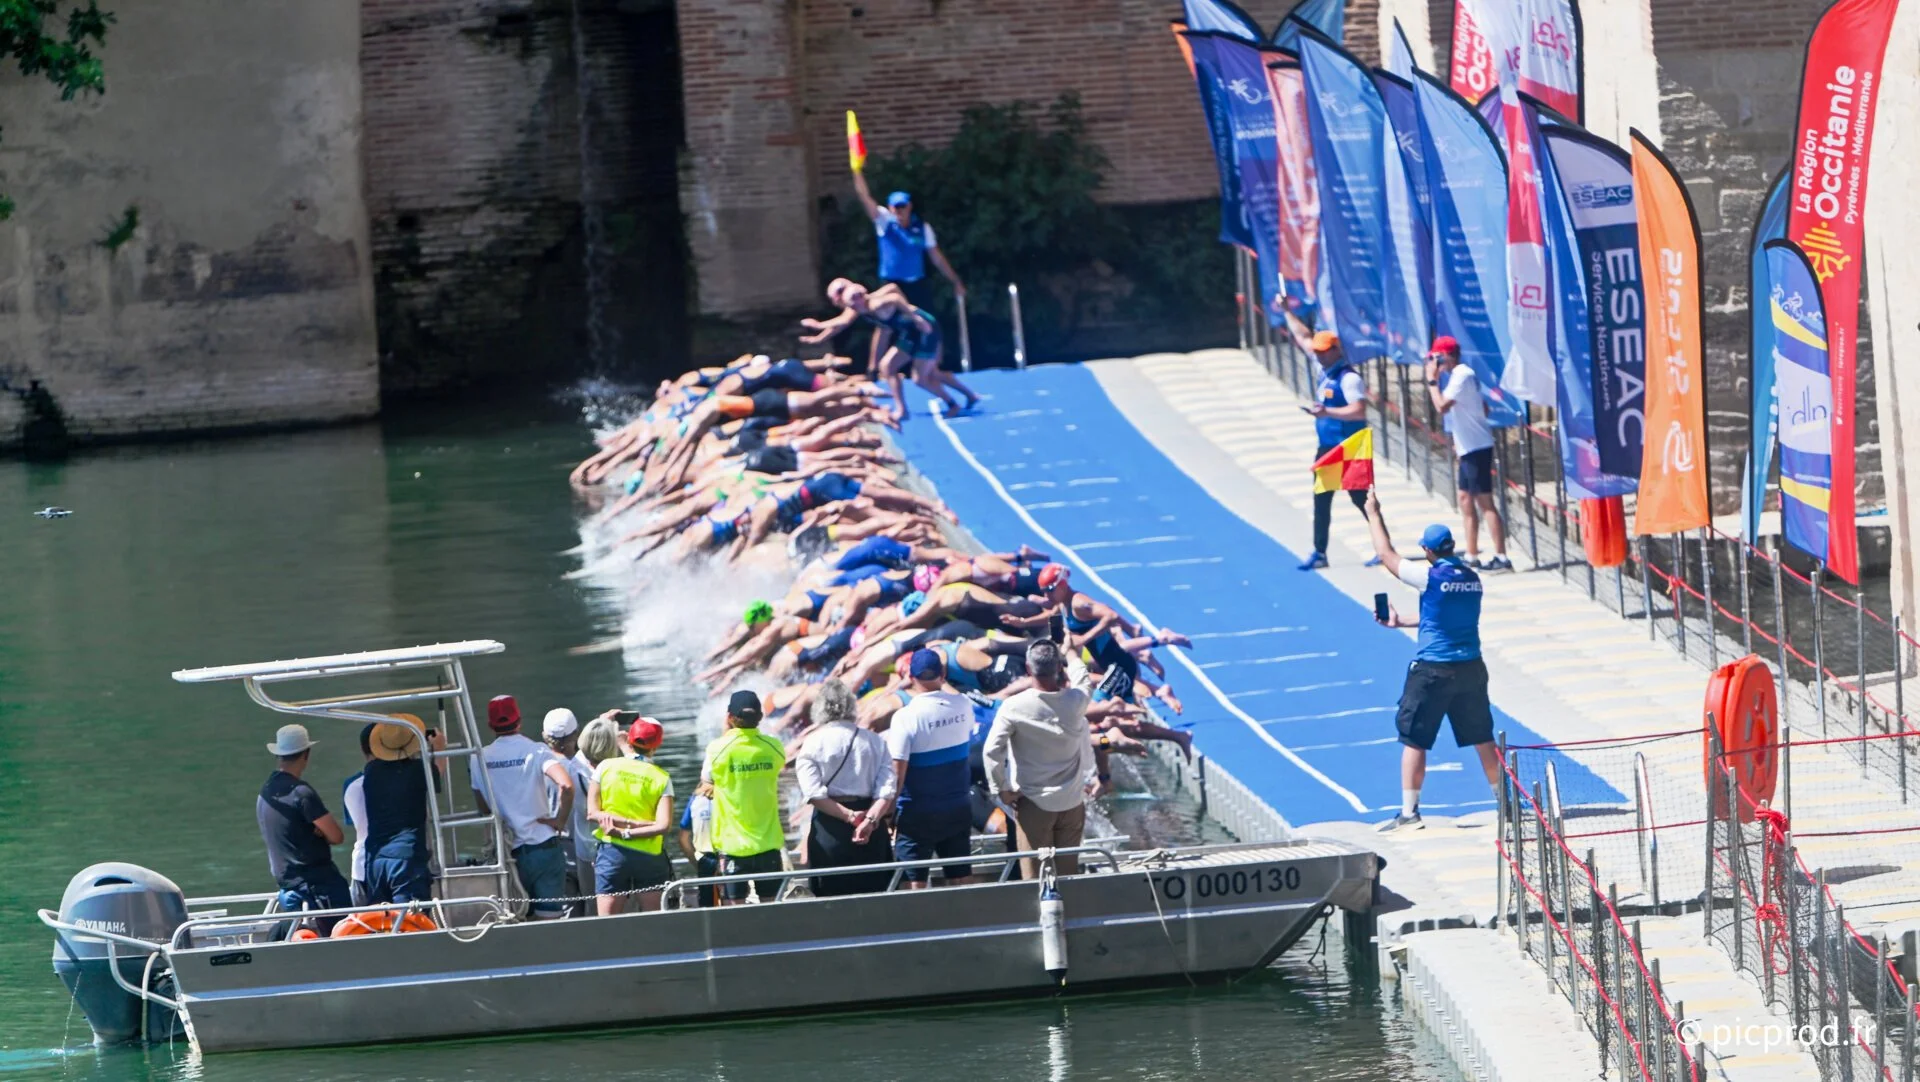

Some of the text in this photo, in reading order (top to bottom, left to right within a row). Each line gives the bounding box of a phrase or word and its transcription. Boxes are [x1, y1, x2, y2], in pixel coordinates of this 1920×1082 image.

[1454, 63, 1466, 84] La
[1796, 128, 1818, 214] La Région
[1814, 65, 1856, 220] Occitanie
[1844, 71, 1873, 224] Pyrénées Méditerranée
[1572, 186, 1631, 204] ESEAC
[1591, 251, 1612, 412] Services Nautiques
[1605, 247, 1645, 448] ESEAC
[928, 713, 966, 730] FRANCE
[1143, 866, 1301, 901] TO 000130
[86, 920, 127, 934] YAMAHA
